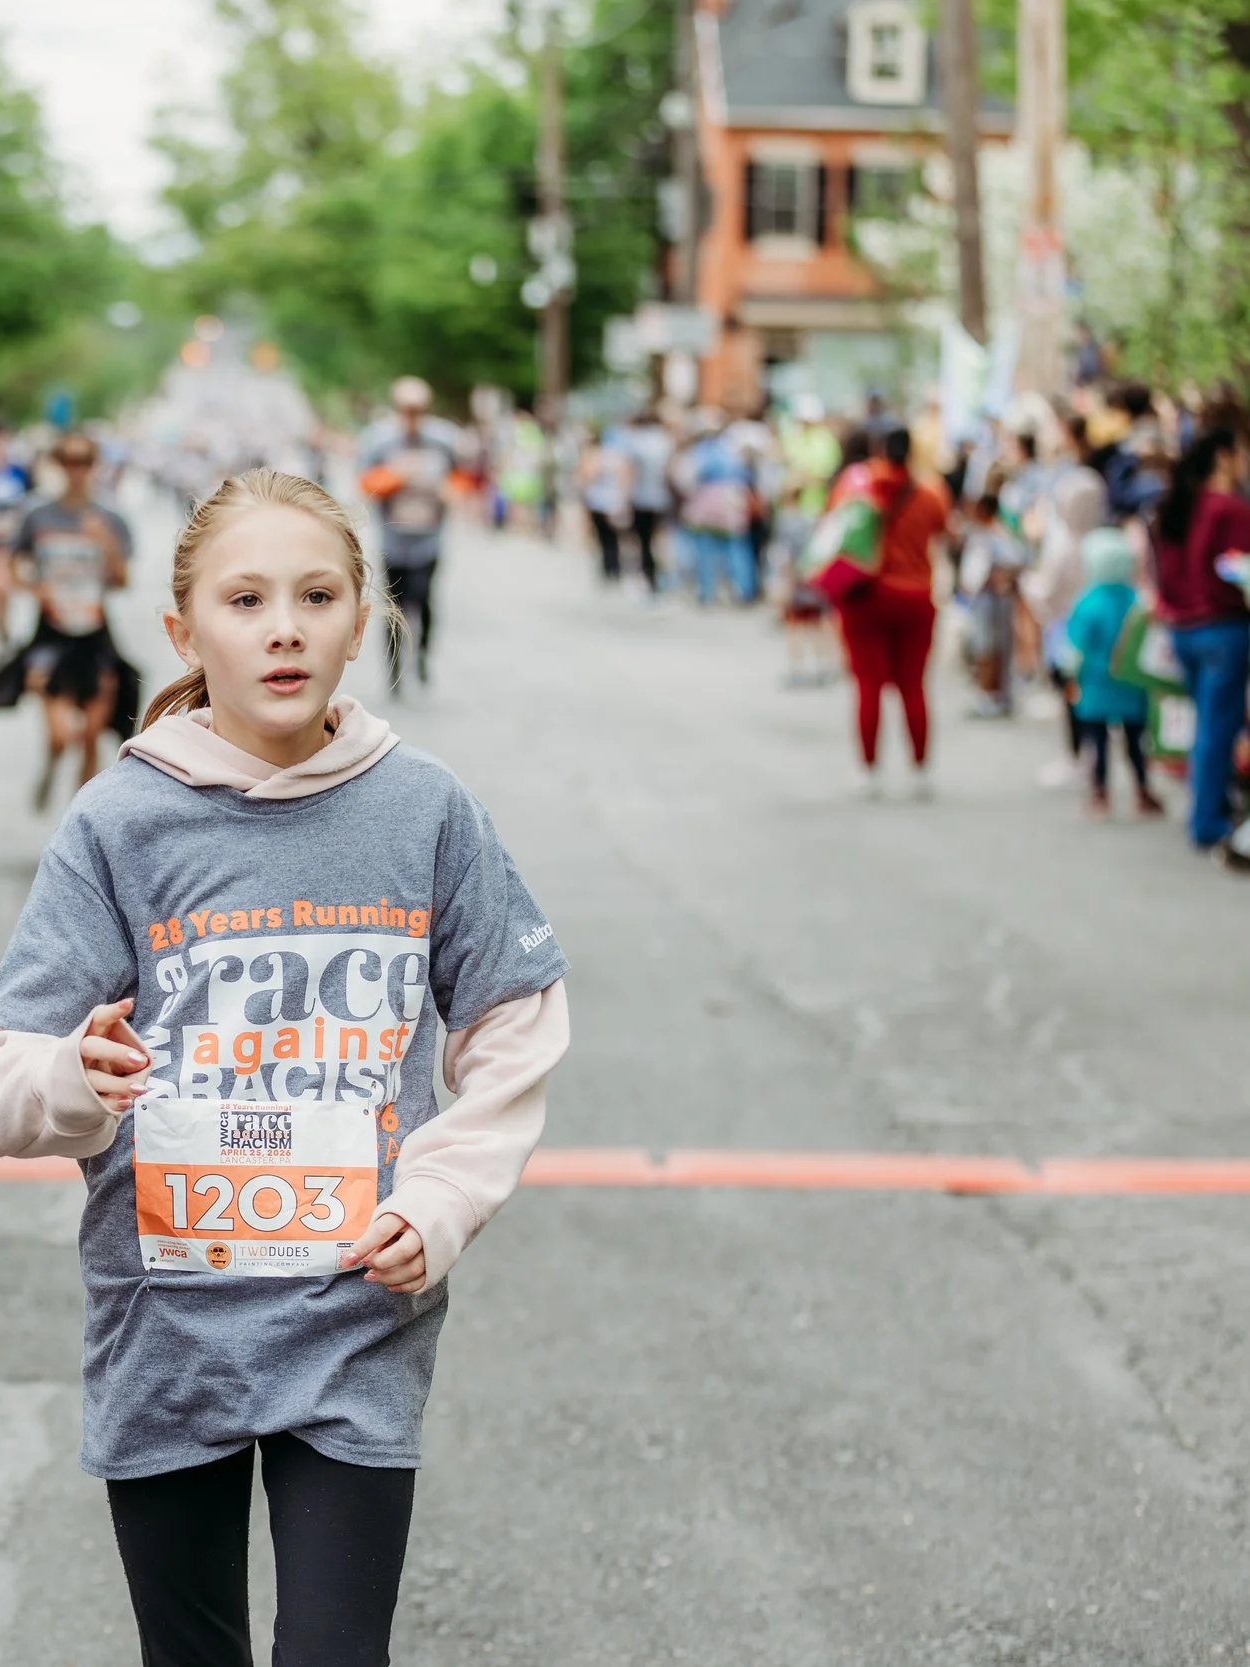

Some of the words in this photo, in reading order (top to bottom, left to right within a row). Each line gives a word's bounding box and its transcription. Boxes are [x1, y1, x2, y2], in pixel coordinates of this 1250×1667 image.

[149, 917, 184, 951] 28
[188, 906, 283, 938] Years
[191, 948, 429, 1024] race
[193, 1016, 409, 1076] against
[232, 1103, 254, 1111] Years
[220, 1111, 230, 1147] ywca
[231, 1114, 291, 1131] race
[231, 1135, 291, 1149] RACISM
[250, 1149, 264, 1157] 25,
[164, 1173, 346, 1232] 1203
[159, 1248, 188, 1258] ywca
